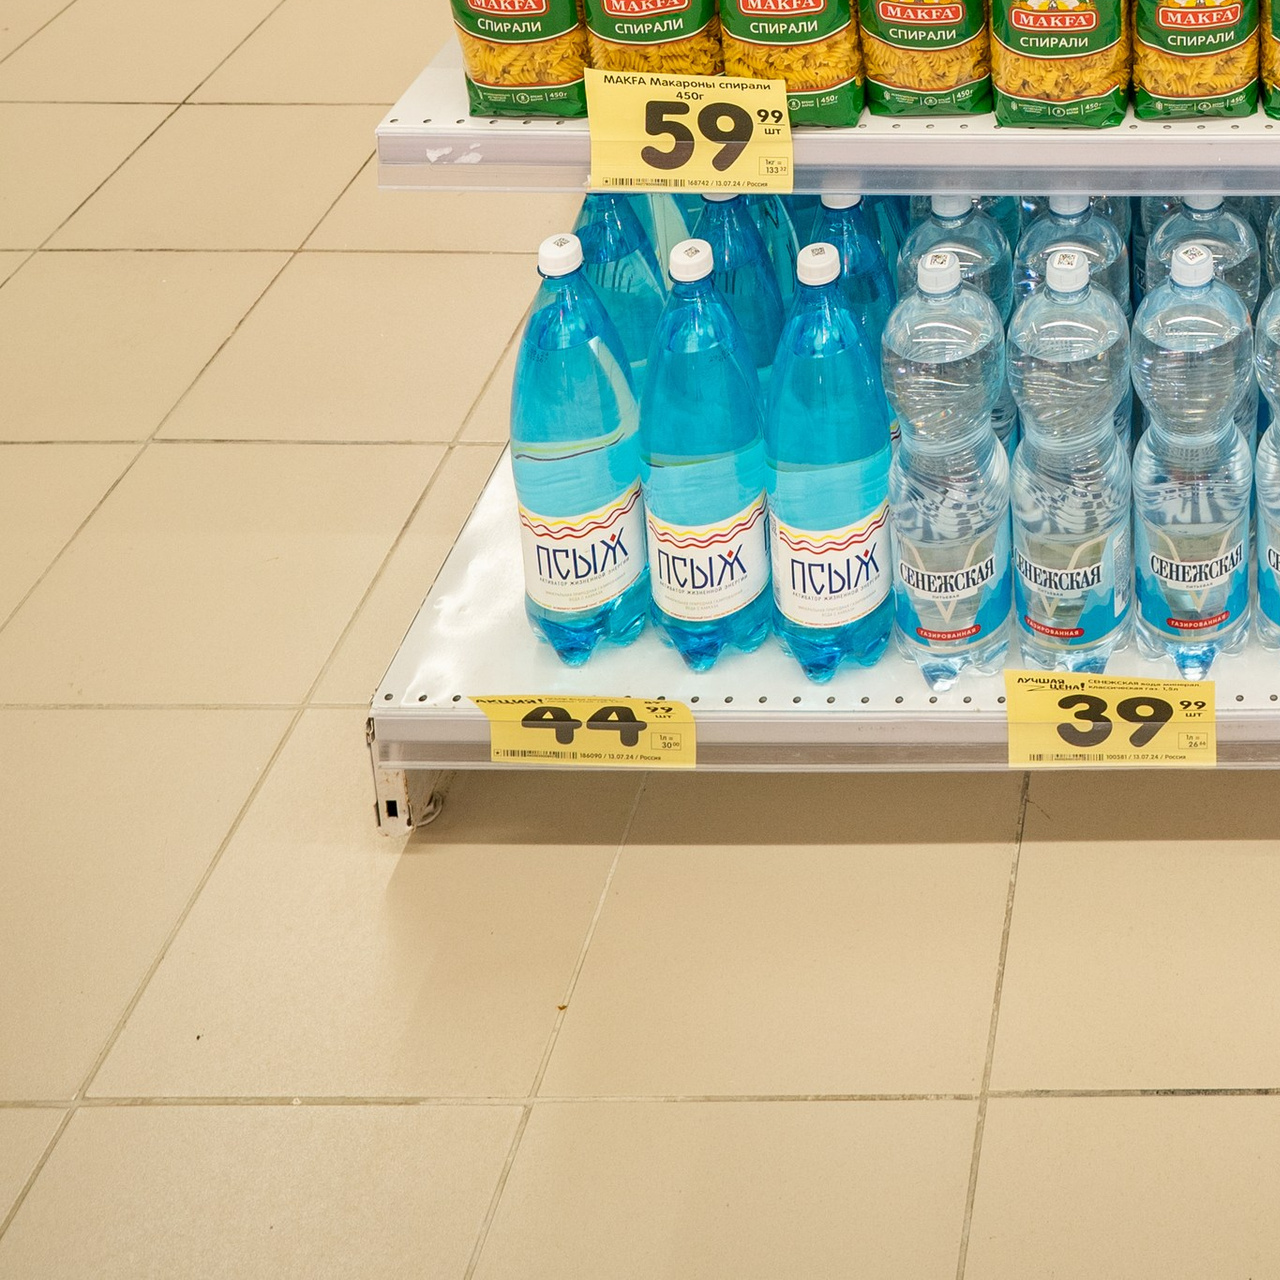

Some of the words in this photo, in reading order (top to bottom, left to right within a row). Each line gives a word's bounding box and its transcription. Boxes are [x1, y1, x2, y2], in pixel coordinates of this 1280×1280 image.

[750, 21, 818, 34] СПИРАЛИ
[1020, 12, 1089, 27] MAKFA
[1020, 35, 1088, 48] СПИРАЛИ
[604, 75, 646, 85] MAKFA
[650, 78, 715, 89] Макароны
[719, 82, 770, 91] спирали
[676, 92, 704, 100] 450г
[641, 101, 754, 171] 59
[757, 109, 783, 123] 99
[536, 528, 627, 579] ПСЫЖ
[659, 544, 746, 588] ПСЫЖ
[791, 543, 880, 595] ПСЫЖ
[1151, 546, 1243, 582] СЕНЕЖСКАЯ
[901, 557, 995, 592] СЕНЕЖСКАЯ
[920, 628, 978, 638] ГАЗИРОВАННАЯ
[522, 706, 647, 747] 44
[1057, 694, 1173, 748] 39
[1180, 701, 1206, 709] 99
